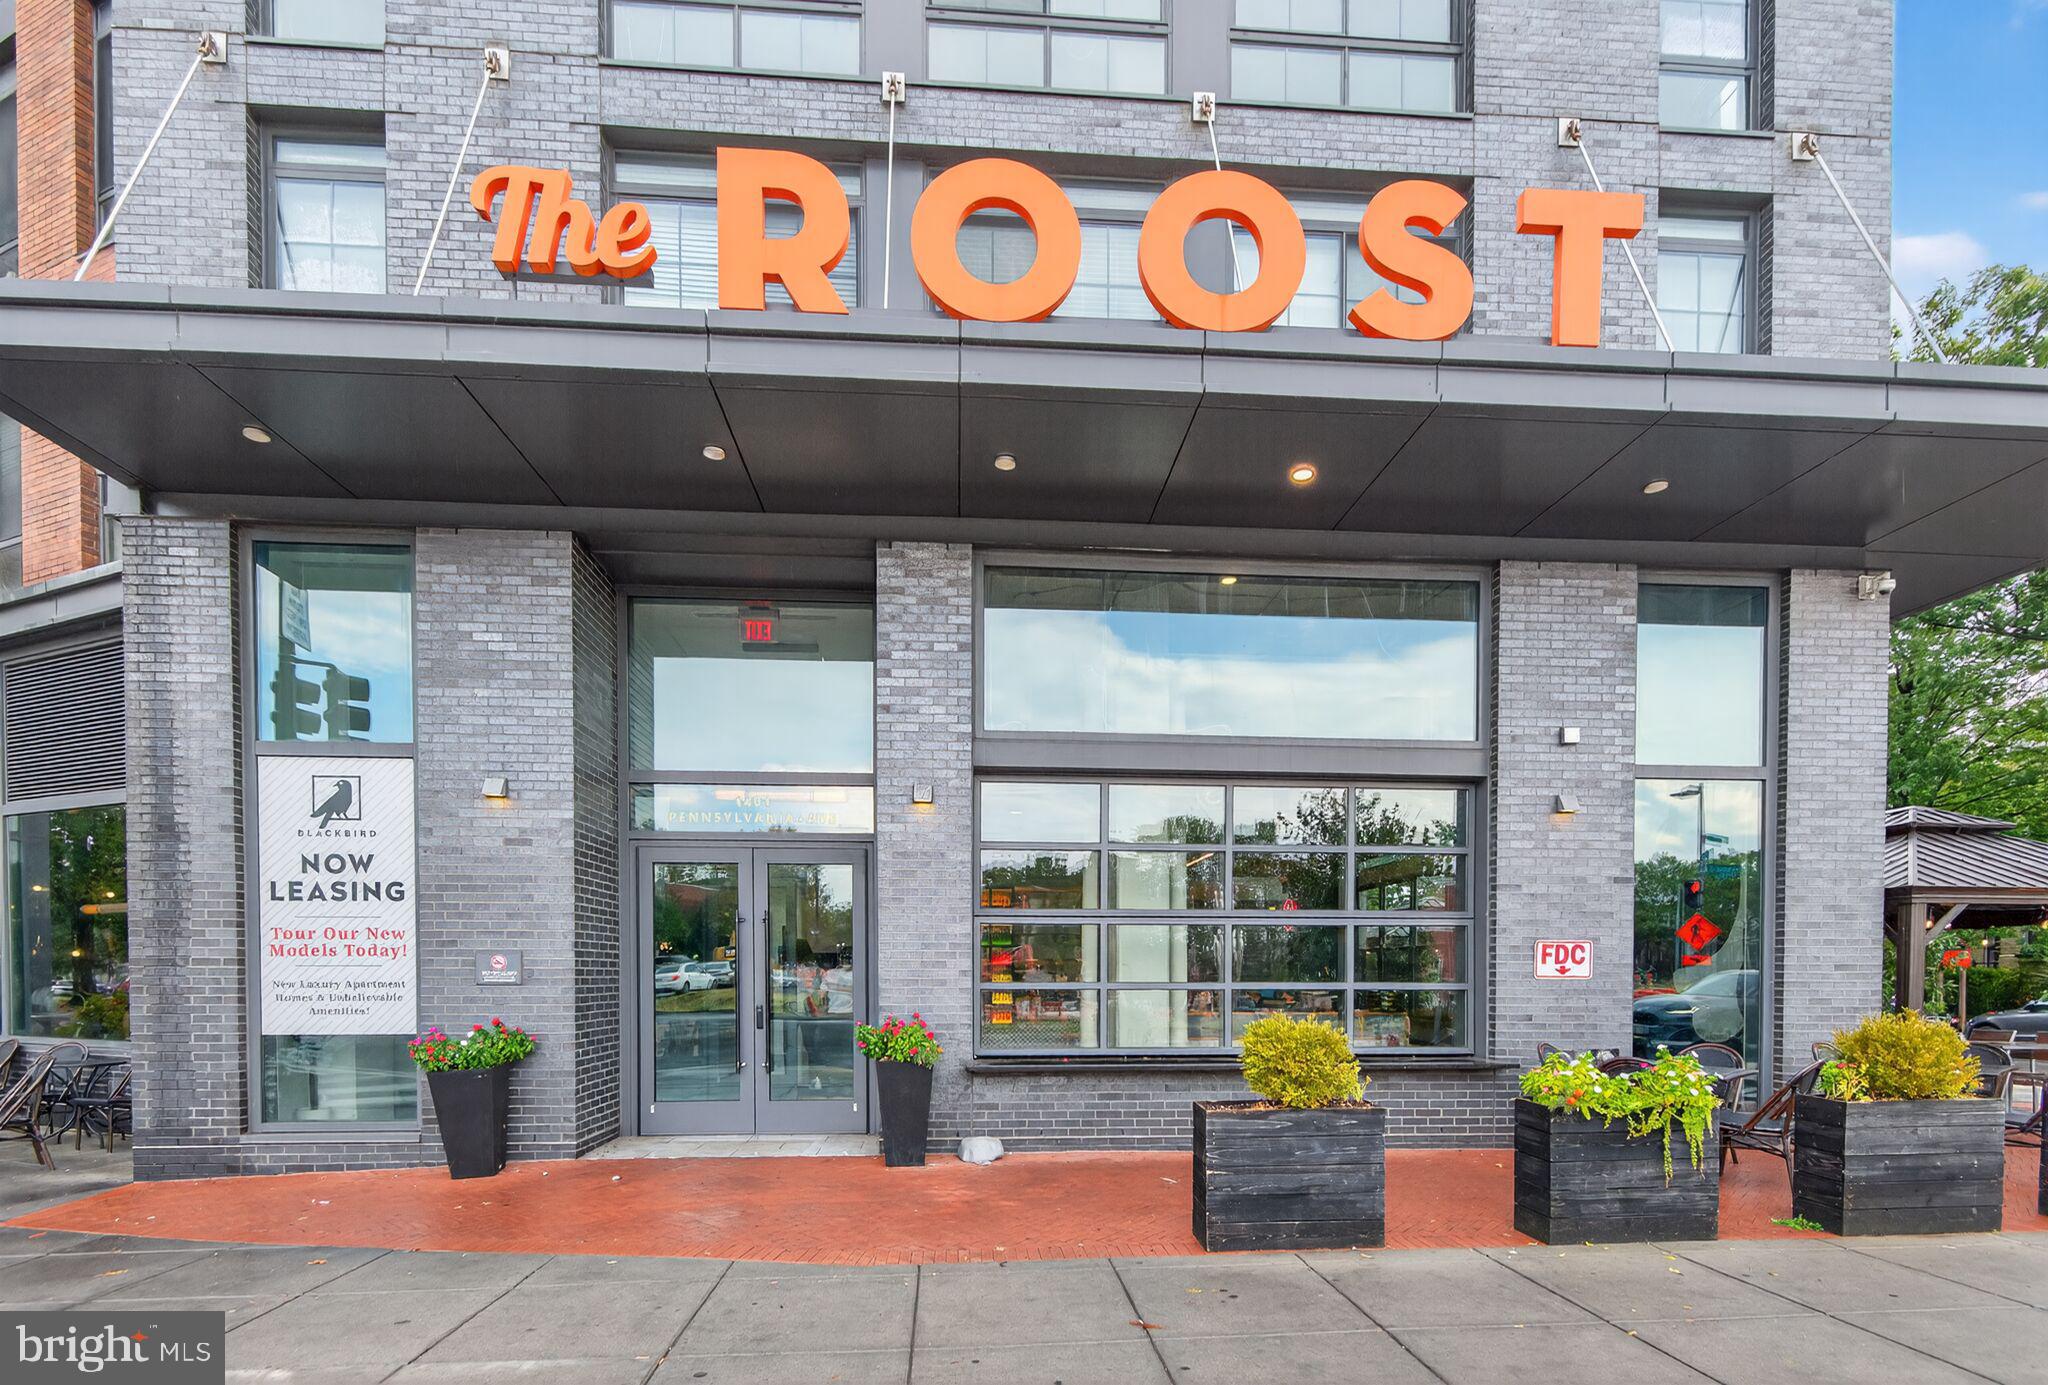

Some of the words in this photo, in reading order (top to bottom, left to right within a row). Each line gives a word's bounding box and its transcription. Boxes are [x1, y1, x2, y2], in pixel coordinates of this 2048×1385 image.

[469, 165, 657, 279] The
[716, 146, 1645, 347] ROOST
[297, 829, 377, 838] BLACKBIRD
[301, 853, 375, 875] NOW
[270, 881, 406, 902] LEASING
[270, 927, 317, 940] Tour
[323, 927, 359, 940] Our
[366, 927, 406, 940] New
[269, 944, 337, 957] Models
[343, 944, 407, 960] Today!
[1541, 944, 1586, 966] FDC
[272, 980, 296, 989] New
[299, 980, 341, 991] Luxury
[344, 980, 406, 991] Apartment
[309, 1007, 370, 1016] Amenities!
